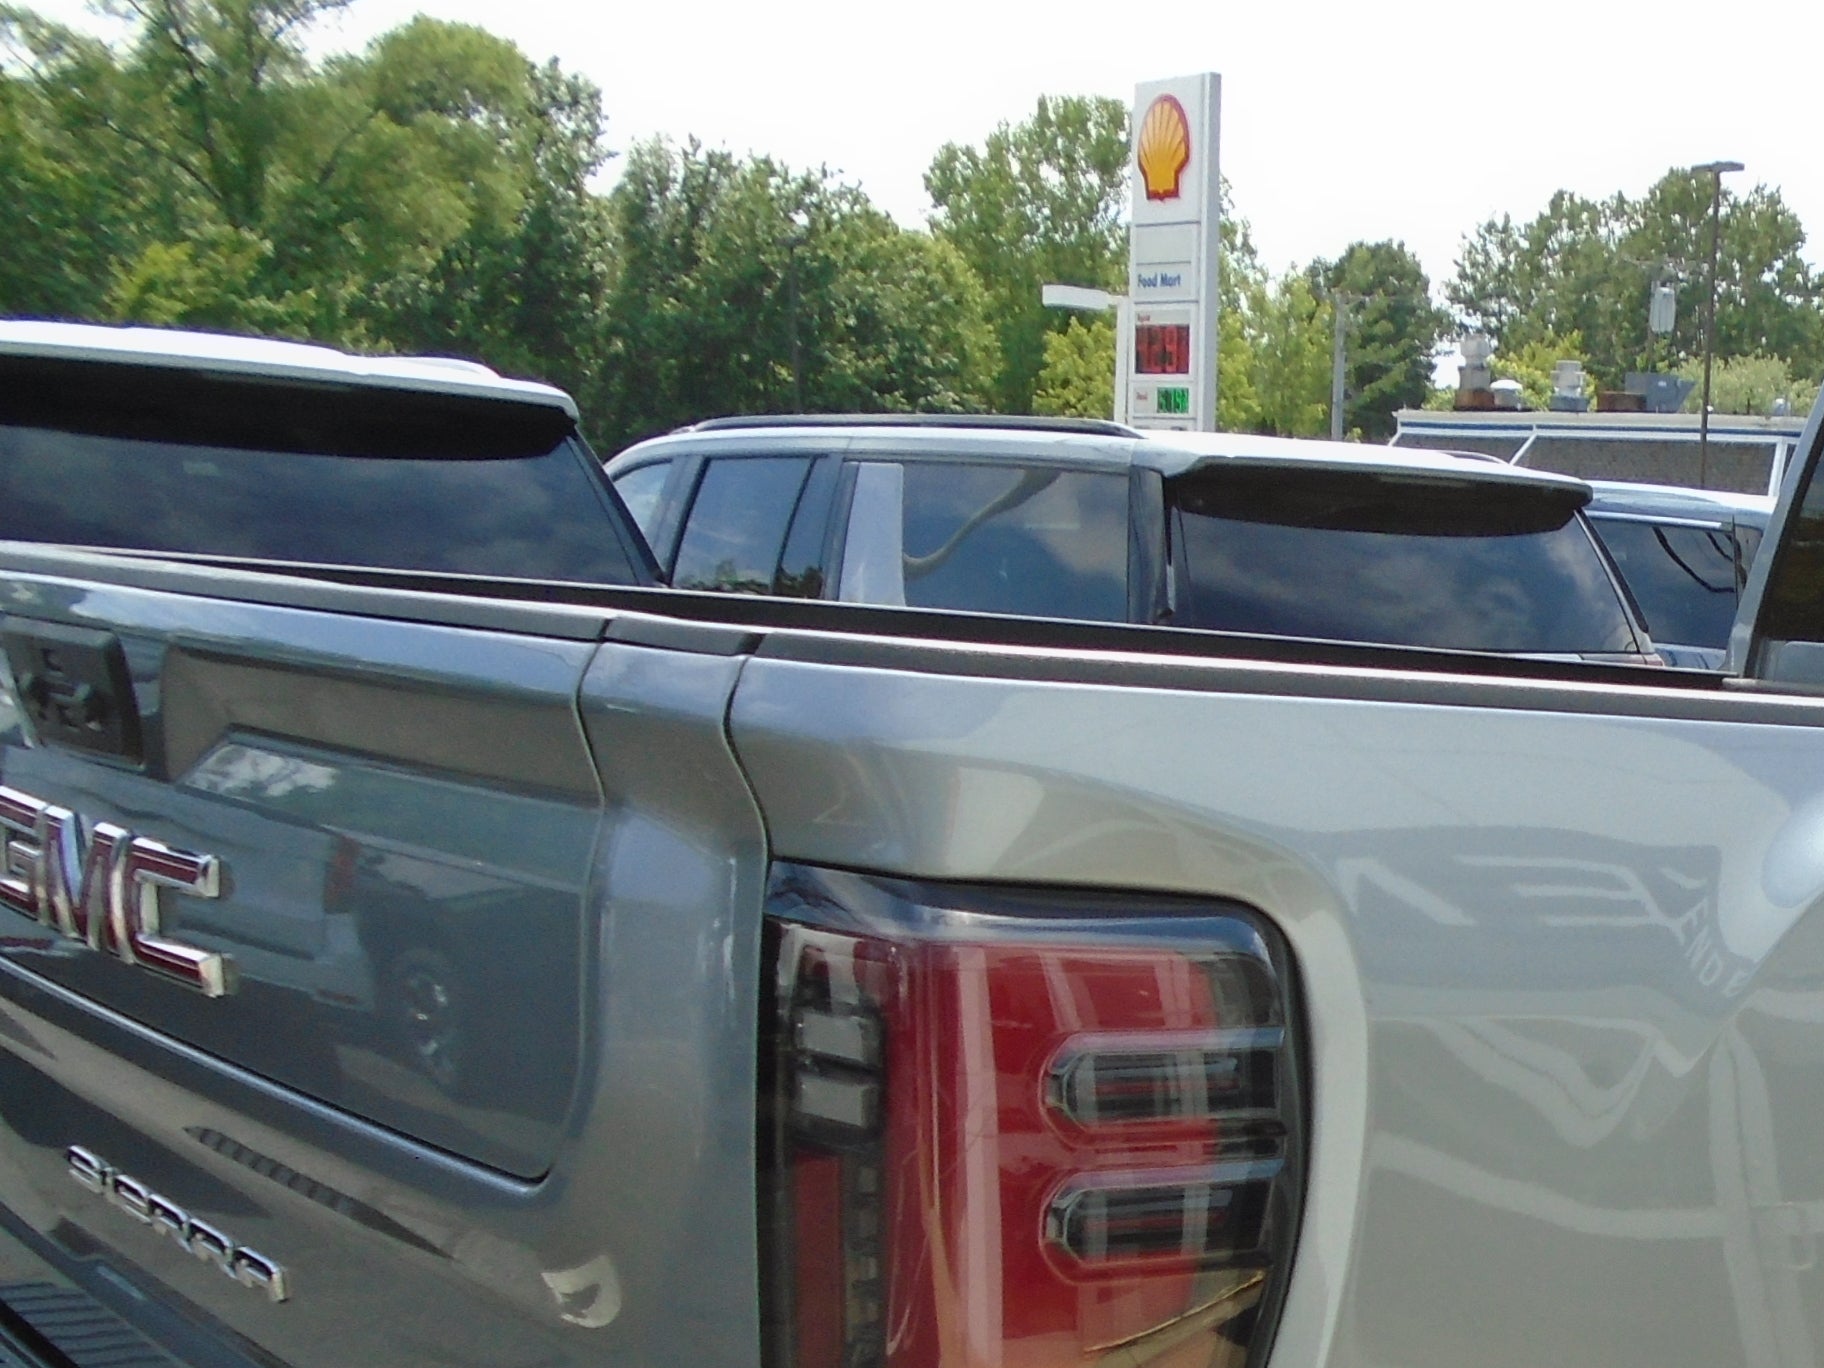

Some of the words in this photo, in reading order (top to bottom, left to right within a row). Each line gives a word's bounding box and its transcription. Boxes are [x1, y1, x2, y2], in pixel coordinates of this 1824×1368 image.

[1137, 273, 1157, 288] Food
[1160, 272, 1181, 287] Mart
[0, 785, 226, 998] GMC
[66, 1144, 290, 1303] SIERRA
